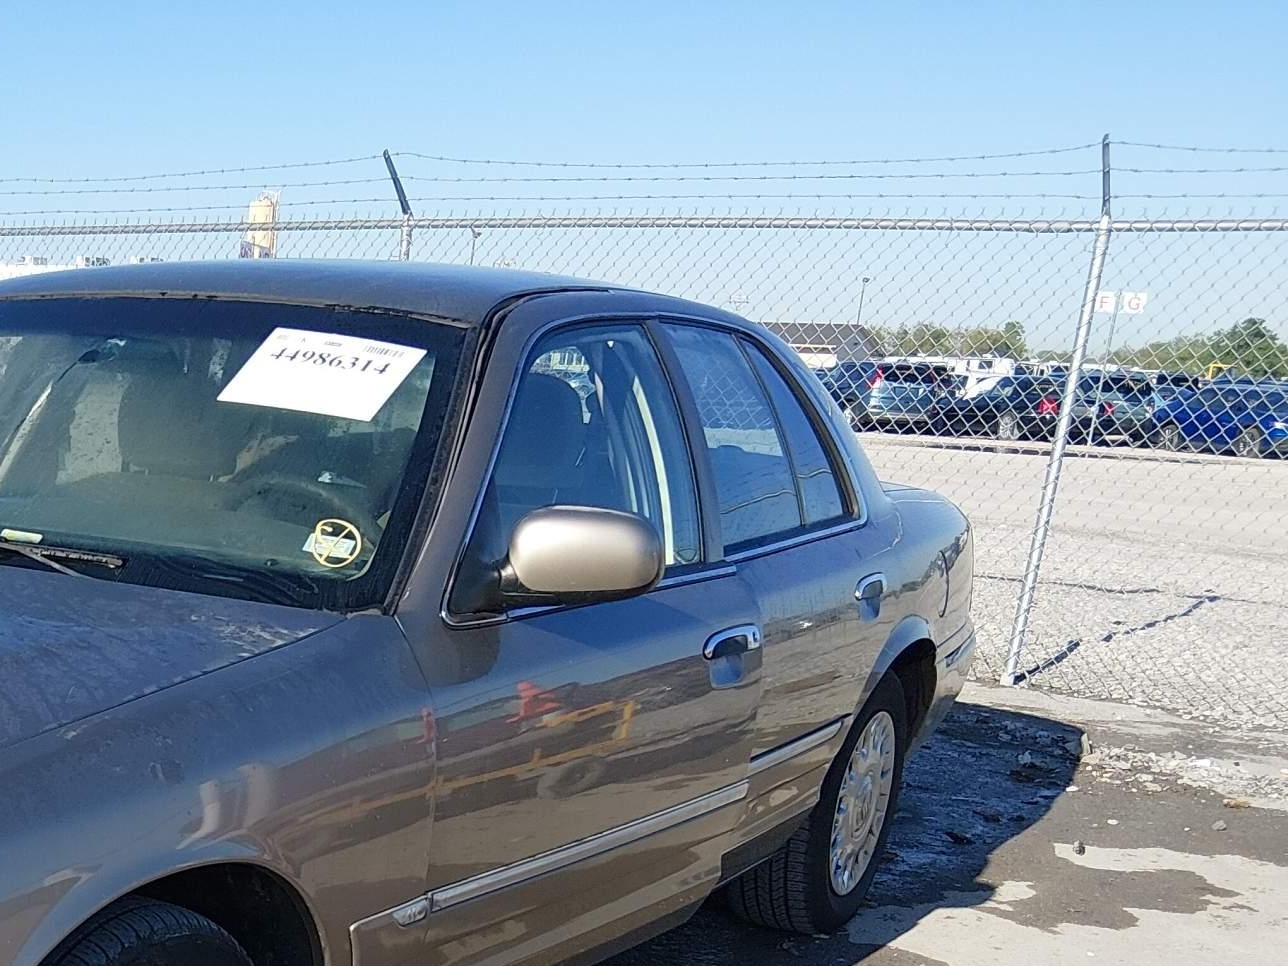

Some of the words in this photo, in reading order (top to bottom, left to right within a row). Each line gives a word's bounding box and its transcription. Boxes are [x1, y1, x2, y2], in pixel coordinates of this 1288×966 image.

[1099, 296, 1111, 309] F
[1127, 296, 1142, 311] G
[271, 347, 391, 374] 44986314
